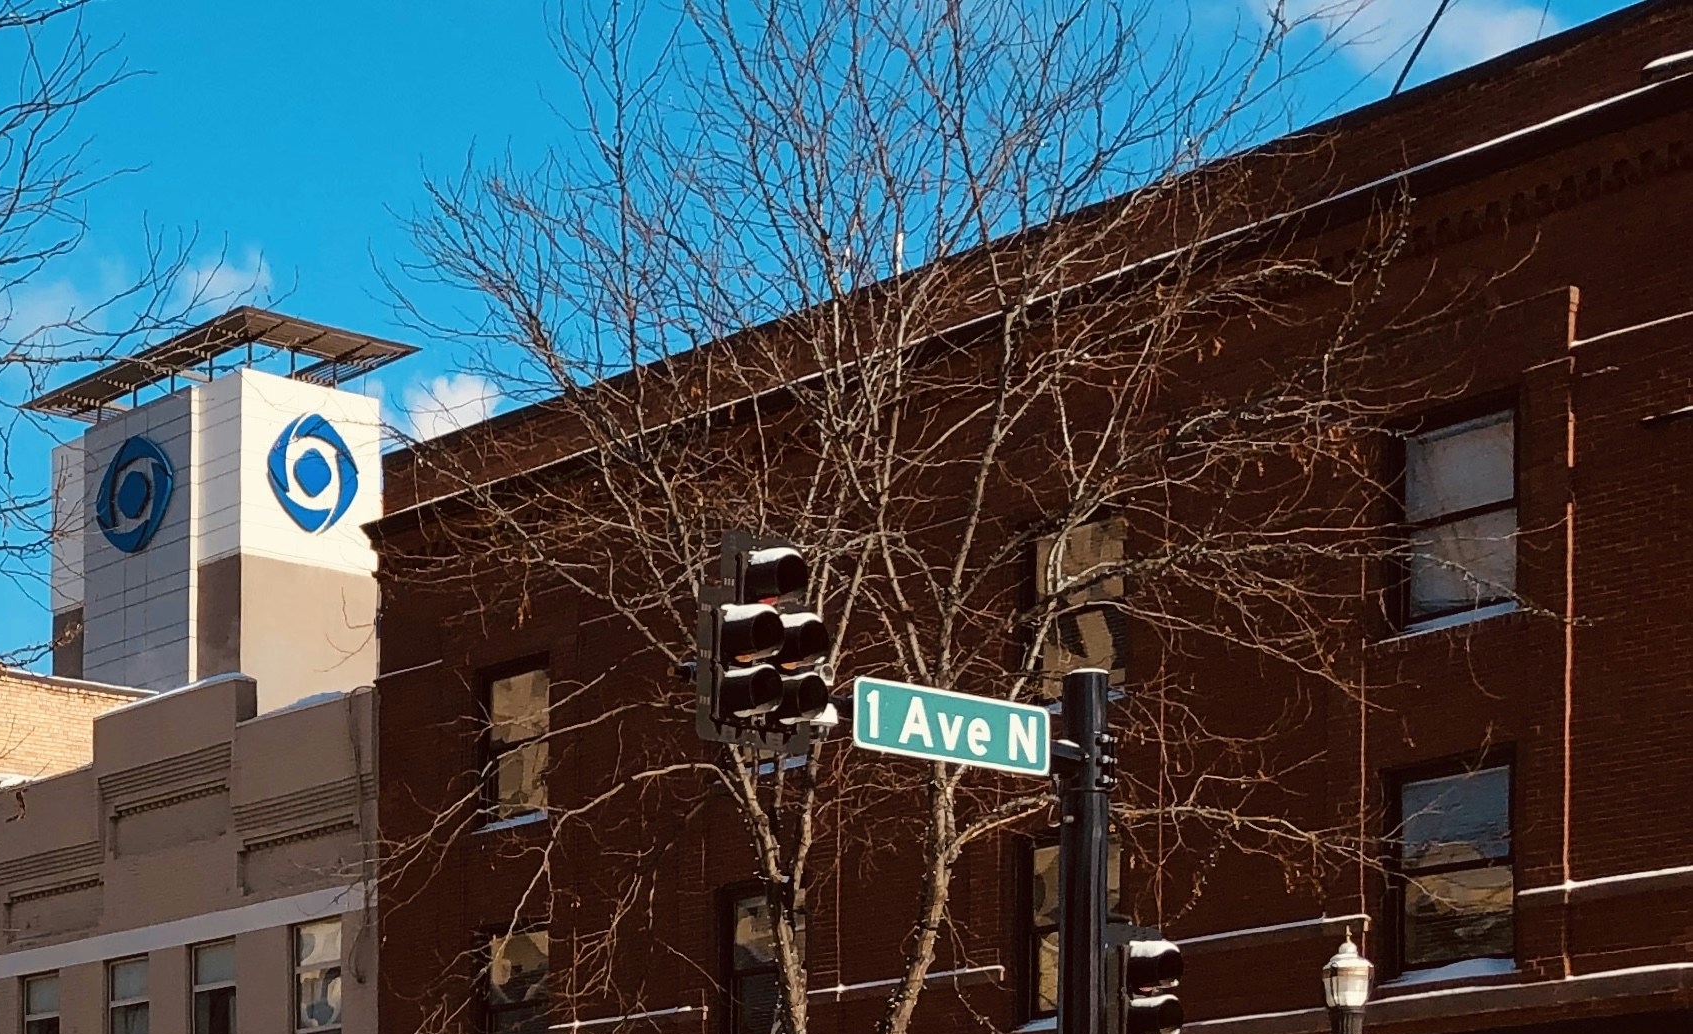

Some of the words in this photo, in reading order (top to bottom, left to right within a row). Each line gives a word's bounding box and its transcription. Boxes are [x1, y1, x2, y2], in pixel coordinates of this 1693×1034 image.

[866, 689, 880, 739] 1
[898, 696, 992, 756] Ave
[1008, 713, 1037, 764] N
